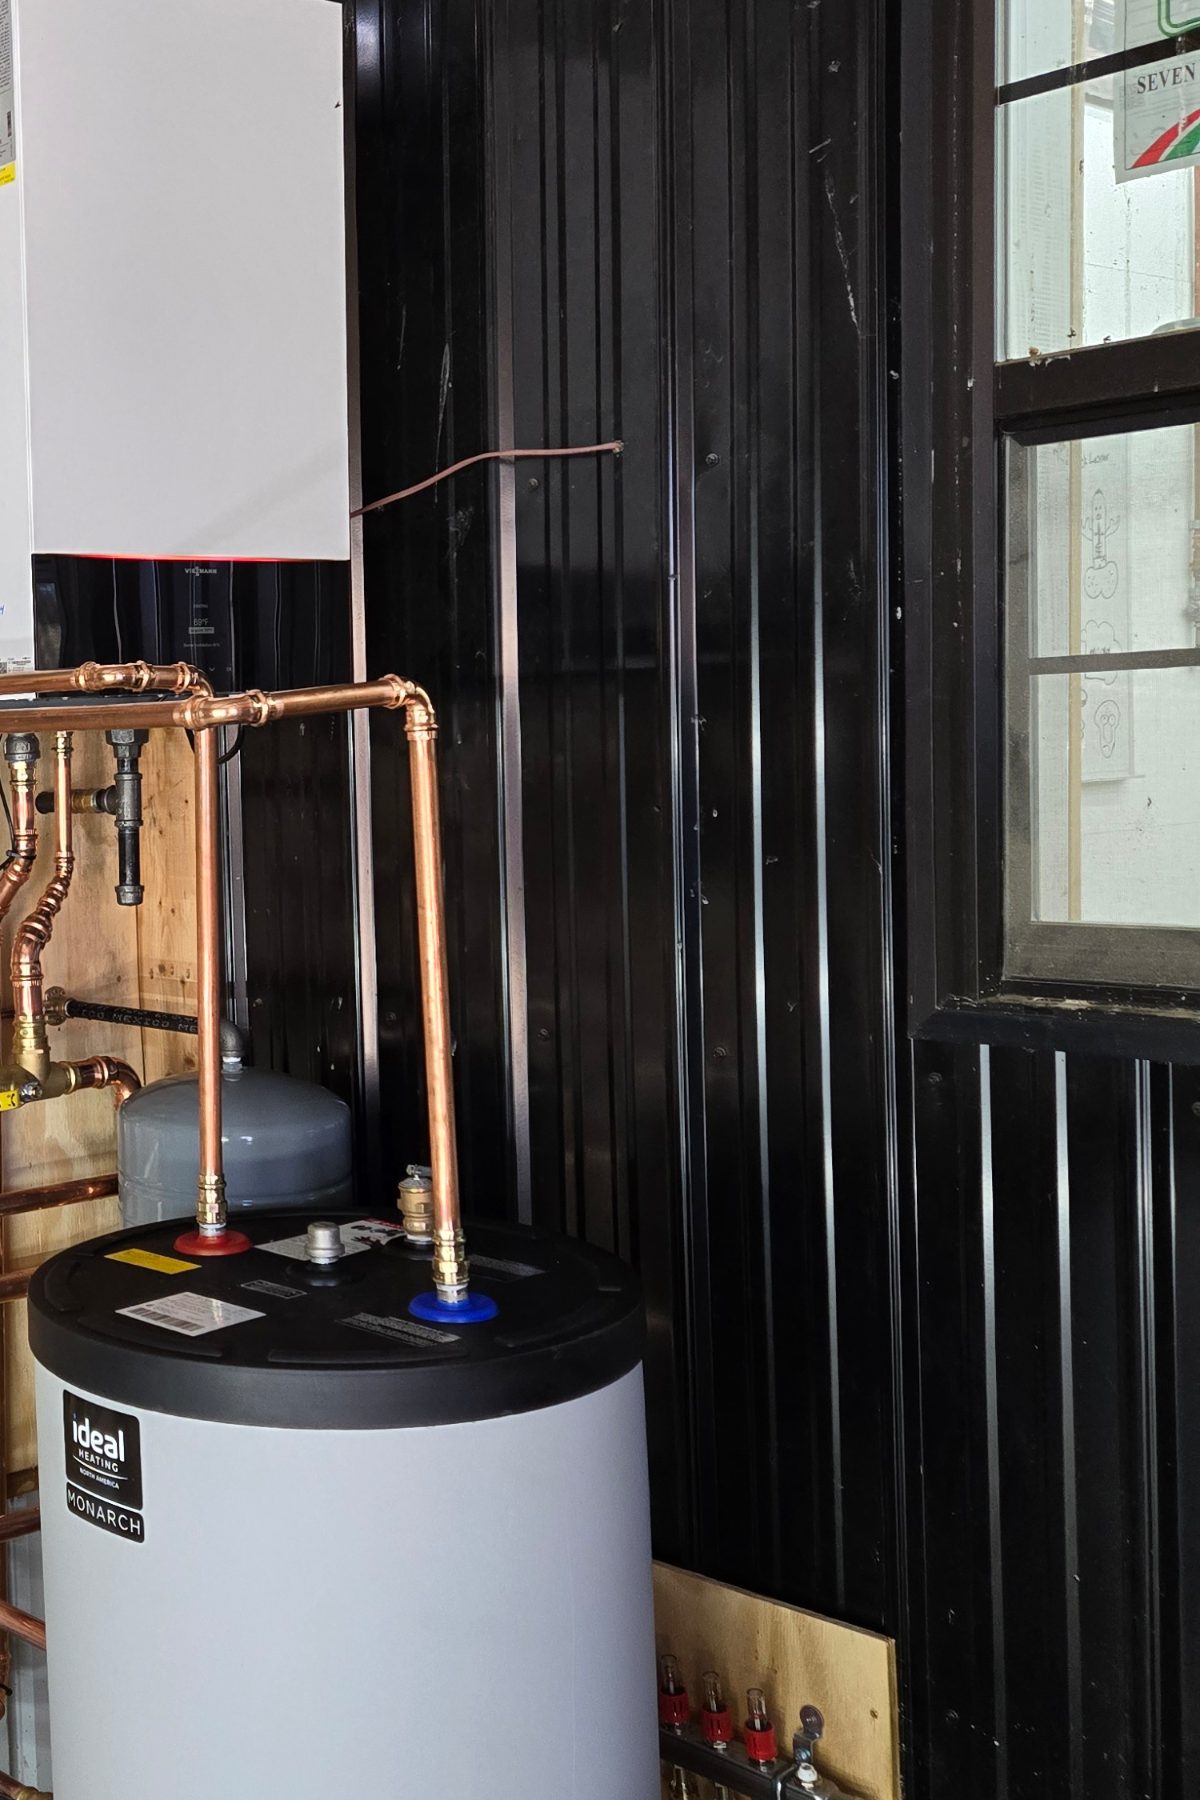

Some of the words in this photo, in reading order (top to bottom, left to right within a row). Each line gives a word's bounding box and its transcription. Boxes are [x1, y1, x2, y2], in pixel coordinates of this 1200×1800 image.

[1136, 62, 1196, 94] SEVEN
[72, 1413, 125, 1463] ideal
[78, 1448, 119, 1473] HEATING
[79, 1467, 95, 1480] NORTH
[96, 1475, 119, 1490] AMERICA
[67, 1488, 141, 1535] MONARCH
